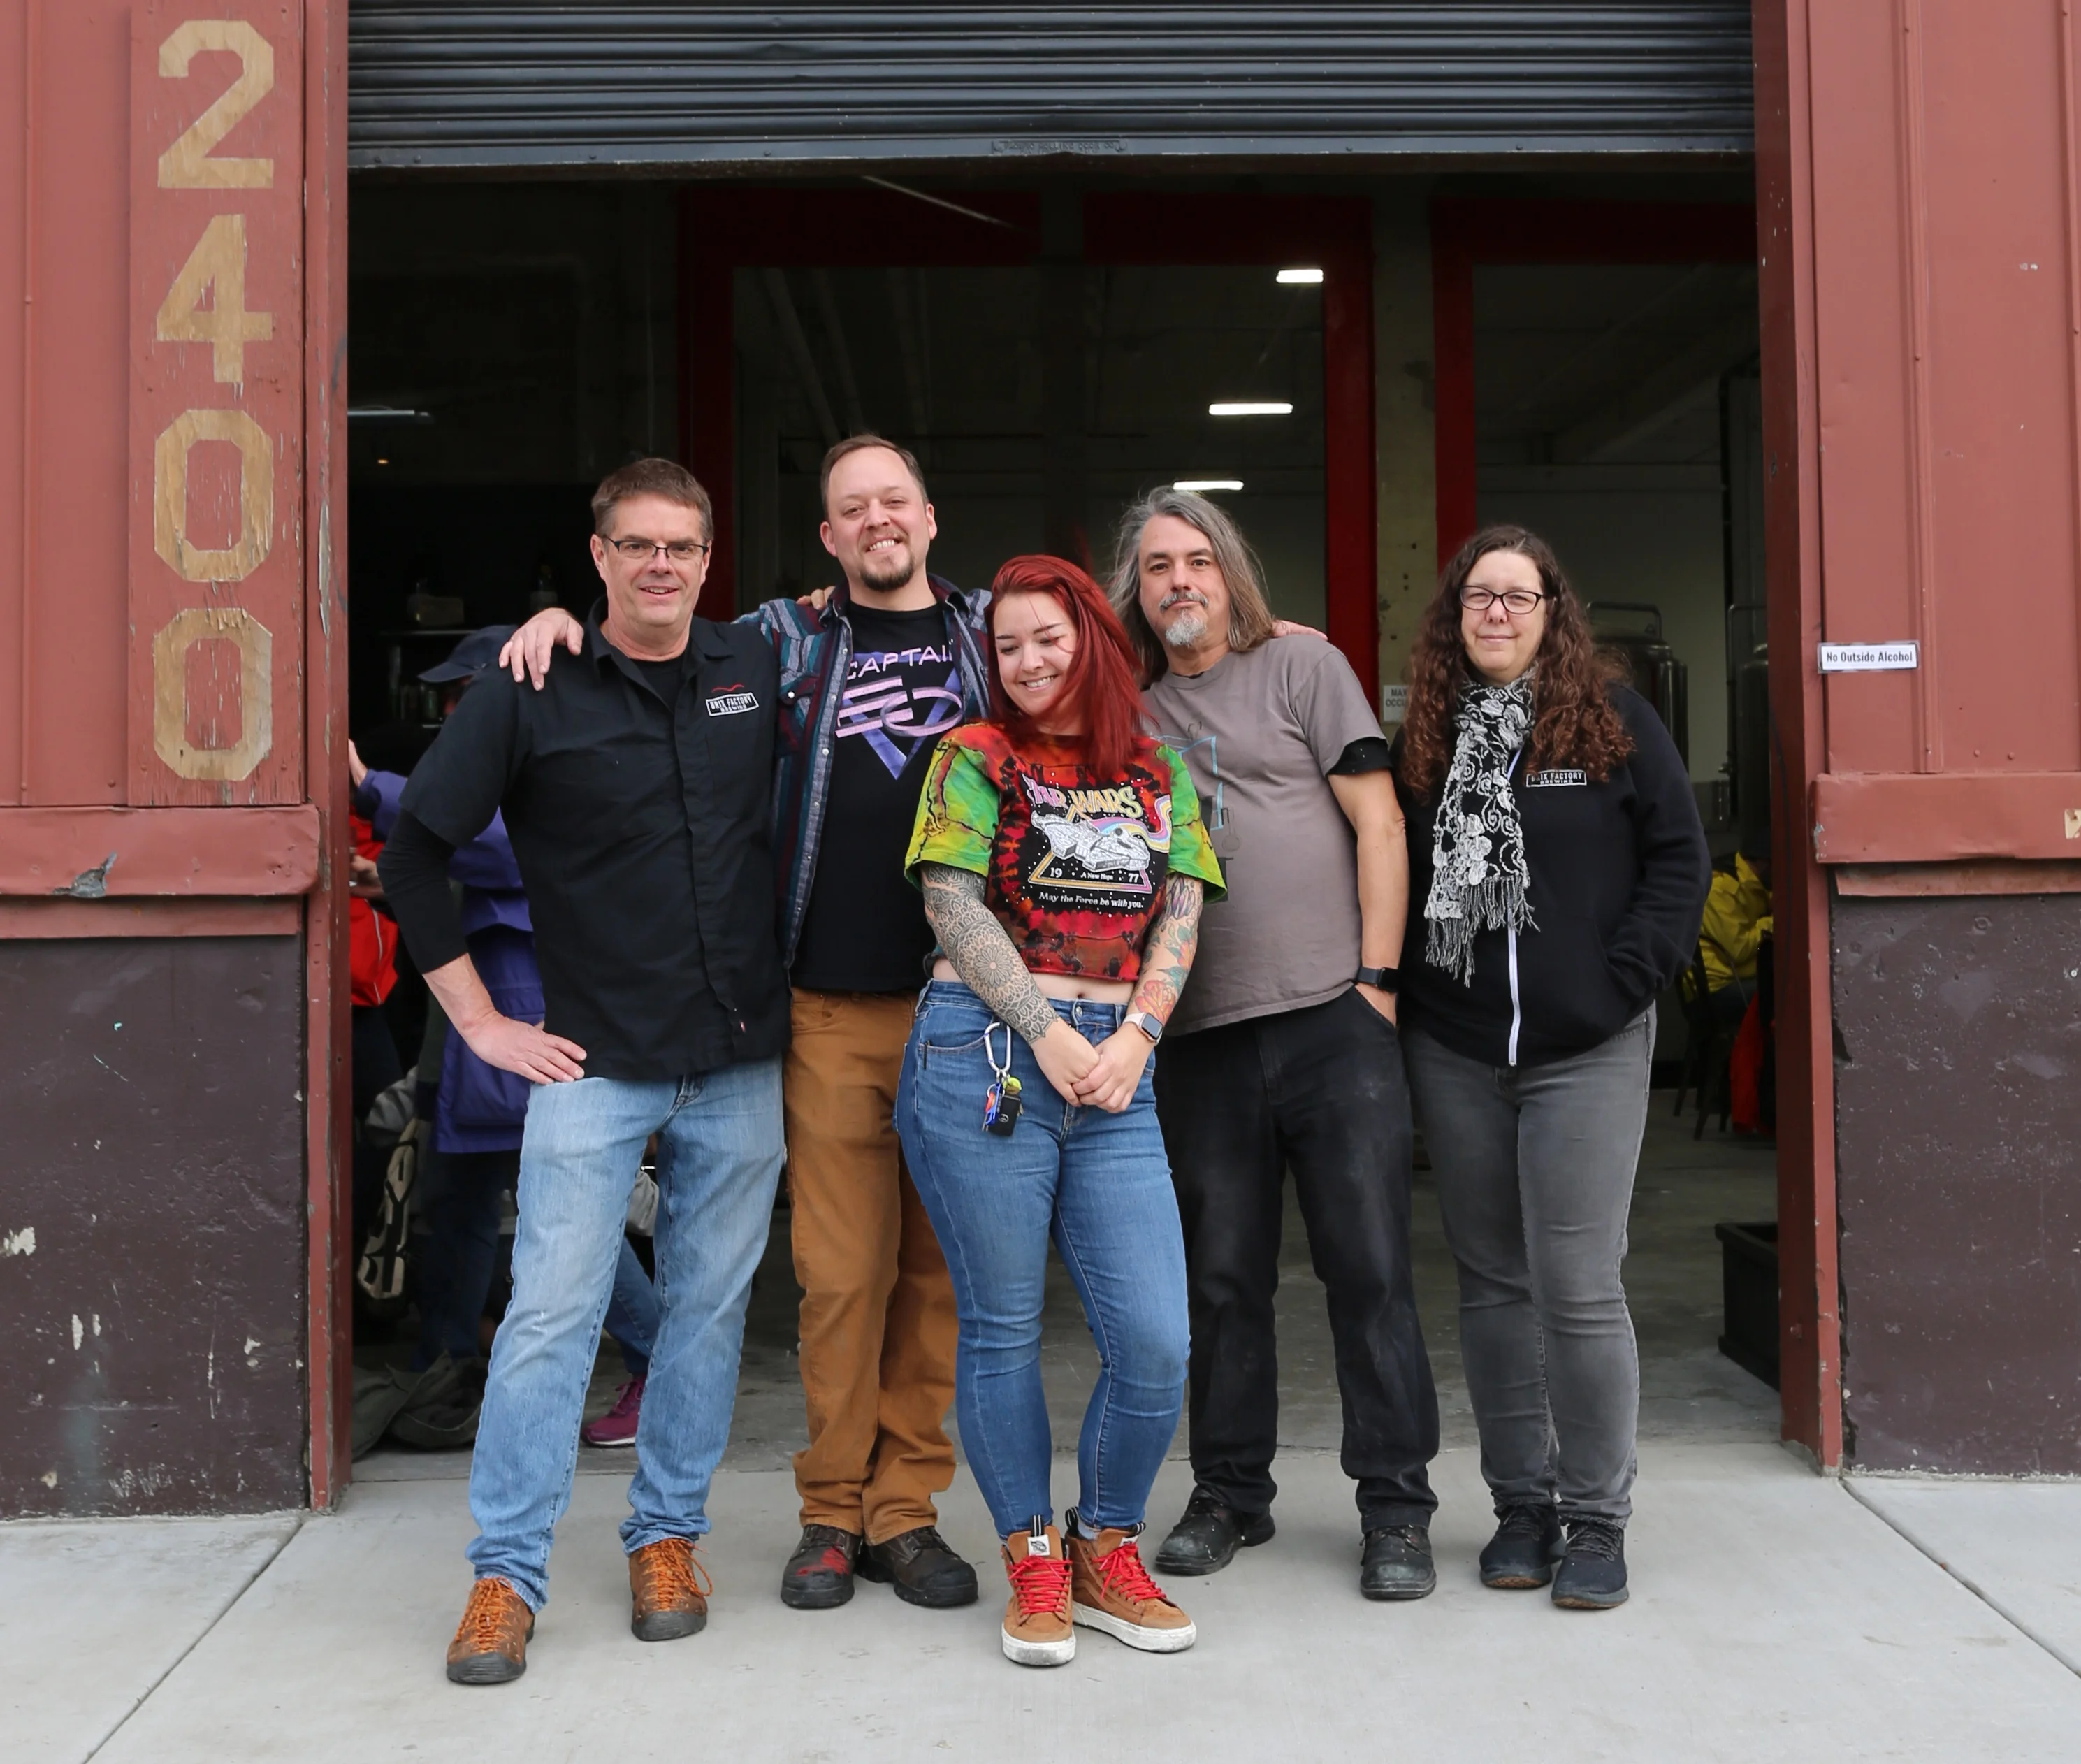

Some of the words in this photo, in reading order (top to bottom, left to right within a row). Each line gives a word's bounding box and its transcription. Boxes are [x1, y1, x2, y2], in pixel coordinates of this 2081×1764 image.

[156, 20, 274, 780] 2400
[1827, 651, 1838, 663] No
[1841, 651, 1875, 663] Outside
[1878, 651, 1913, 663] Alcohol
[726, 695, 753, 707] FACTORY
[1550, 772, 1582, 780] FACTORY
[1068, 786, 1144, 820] WARS
[1050, 867, 1063, 879] 19
[1128, 872, 1140, 883] 77
[1038, 892, 1059, 903] May
[1060, 895, 1073, 903] the
[1075, 895, 1098, 905] Force
[1099, 897, 1110, 906] be
[1111, 899, 1127, 908] with
[1127, 901, 1144, 910] you.
